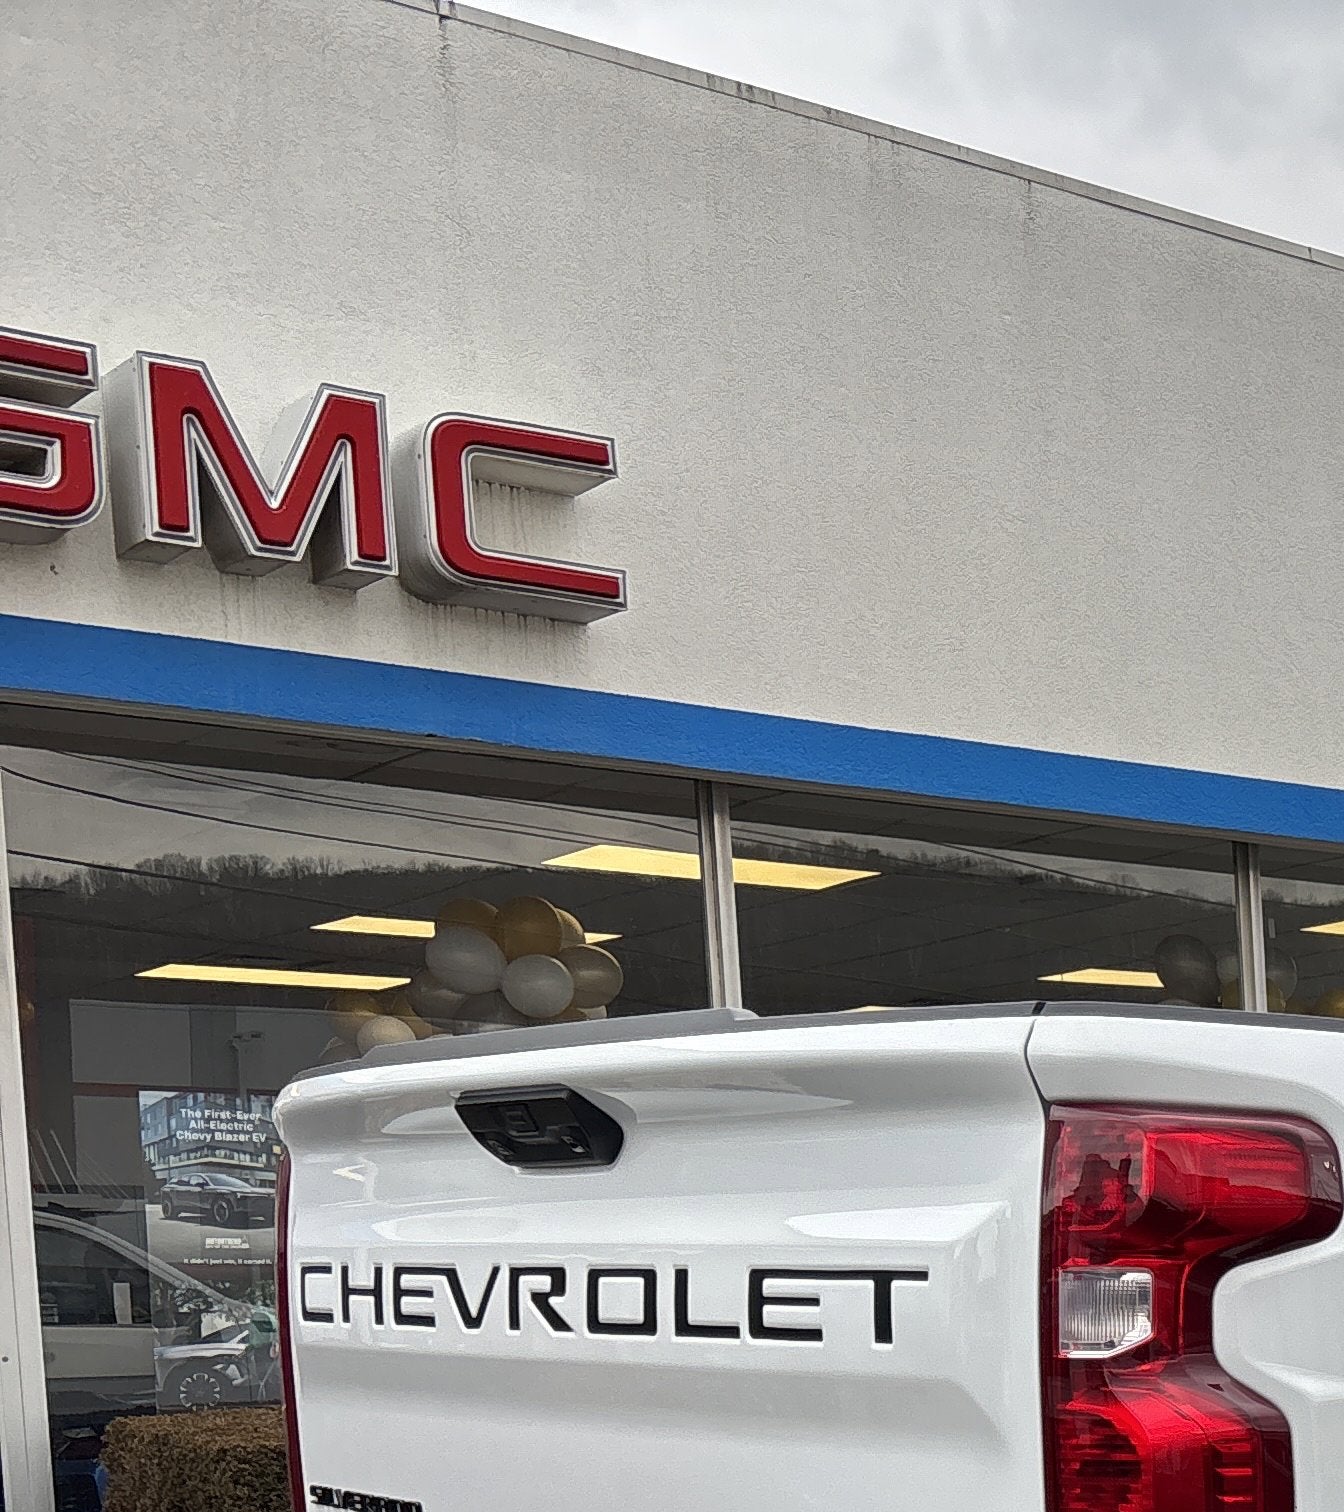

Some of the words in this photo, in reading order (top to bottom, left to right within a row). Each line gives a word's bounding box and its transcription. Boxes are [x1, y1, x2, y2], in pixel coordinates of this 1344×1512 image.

[180, 1108, 202, 1119] The
[204, 1109, 261, 1121] First-Ever
[189, 1120, 254, 1132] All-Electric
[176, 1130, 212, 1143] Chevy
[214, 1131, 250, 1143] Blazer
[252, 1132, 267, 1143] EV
[299, 1263, 930, 1345] CHEVROLET
